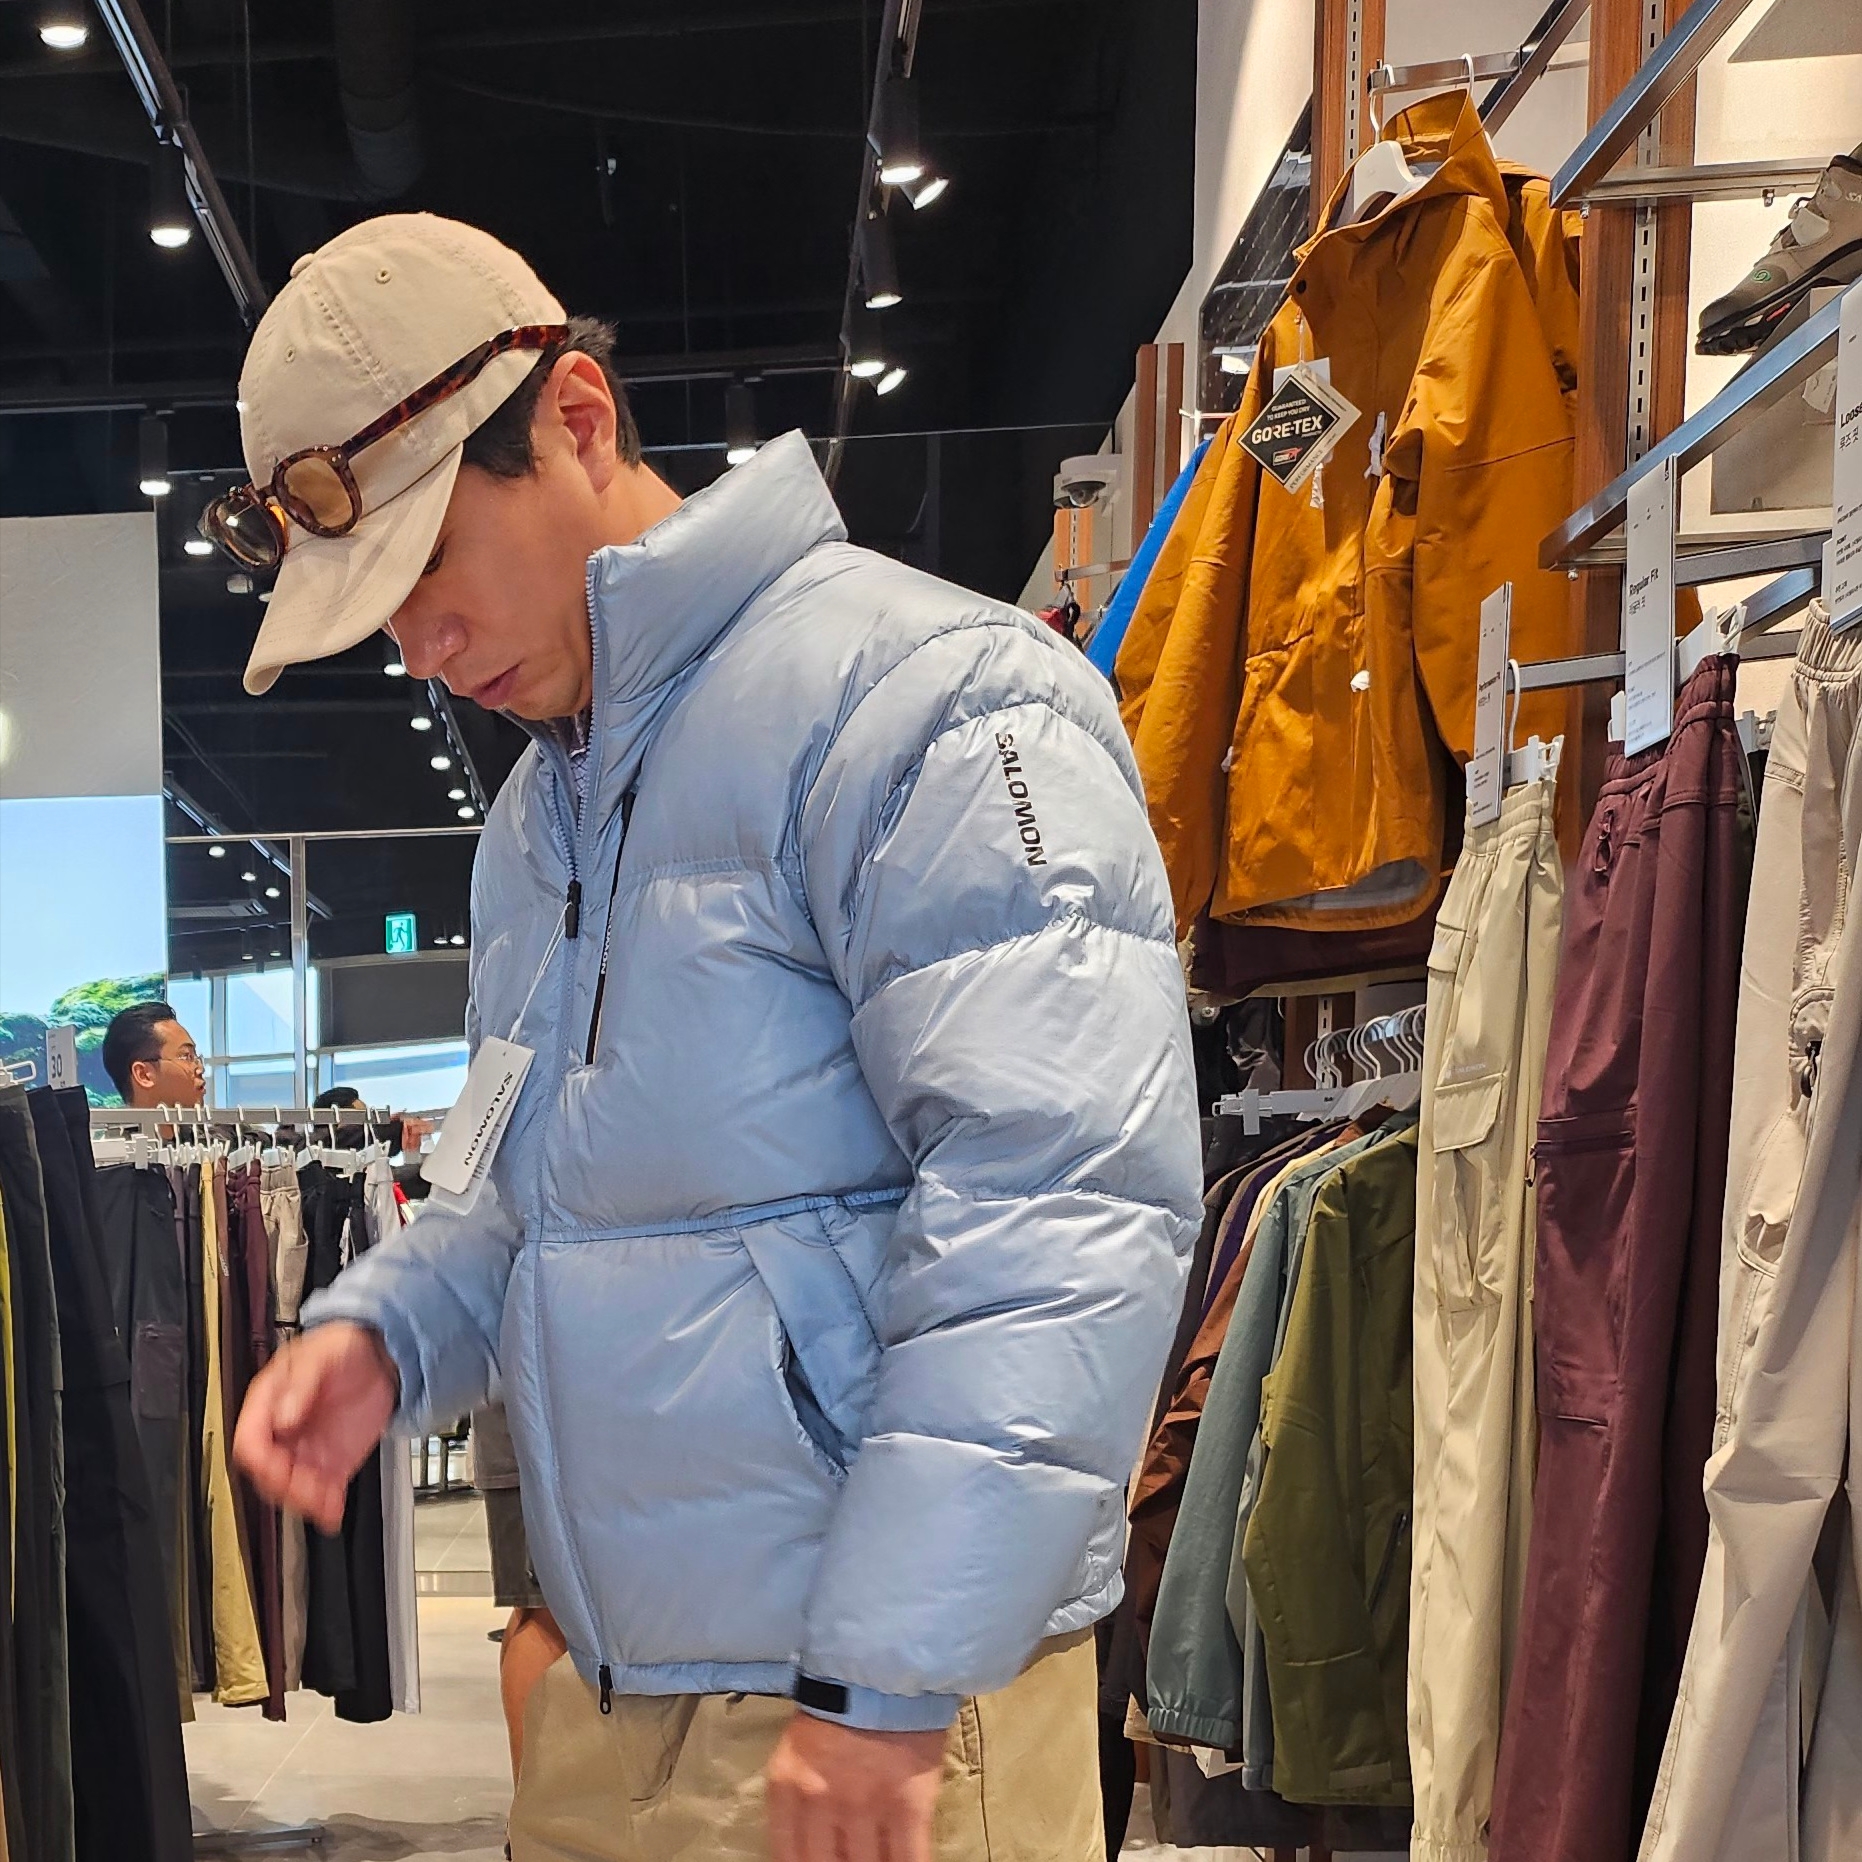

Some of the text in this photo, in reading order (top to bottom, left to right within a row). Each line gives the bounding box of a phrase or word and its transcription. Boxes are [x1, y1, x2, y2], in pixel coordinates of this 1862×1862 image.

[1252, 414, 1322, 445] GORE-TEX
[1629, 567, 1659, 597] Regular Fit
[995, 732, 1048, 867] SALOMON
[51, 1053, 63, 1079] 30
[464, 1071, 513, 1166] SALOMON
